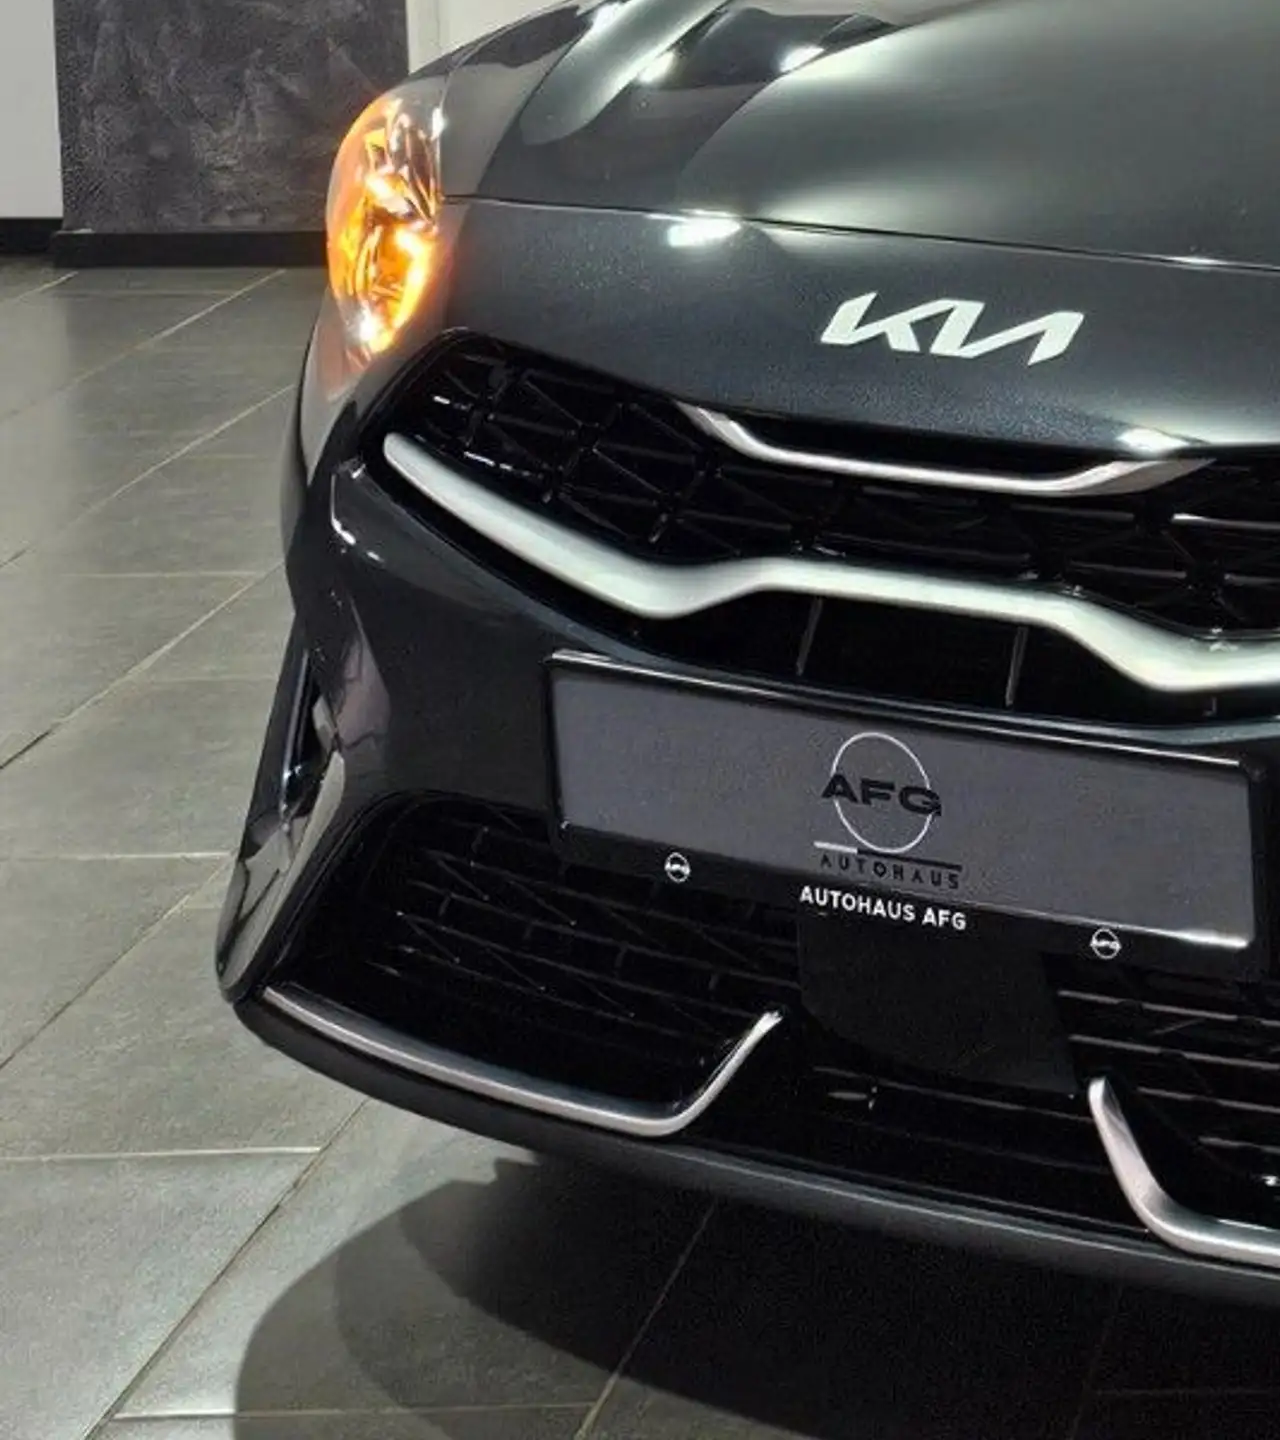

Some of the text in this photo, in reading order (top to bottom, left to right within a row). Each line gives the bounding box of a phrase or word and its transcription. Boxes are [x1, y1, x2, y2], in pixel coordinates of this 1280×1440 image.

[820, 291, 1085, 366] KIA
[821, 772, 942, 817] AFG
[820, 854, 960, 890] AUTOHAUS
[799, 885, 967, 931] AUTOHAUS AFG
